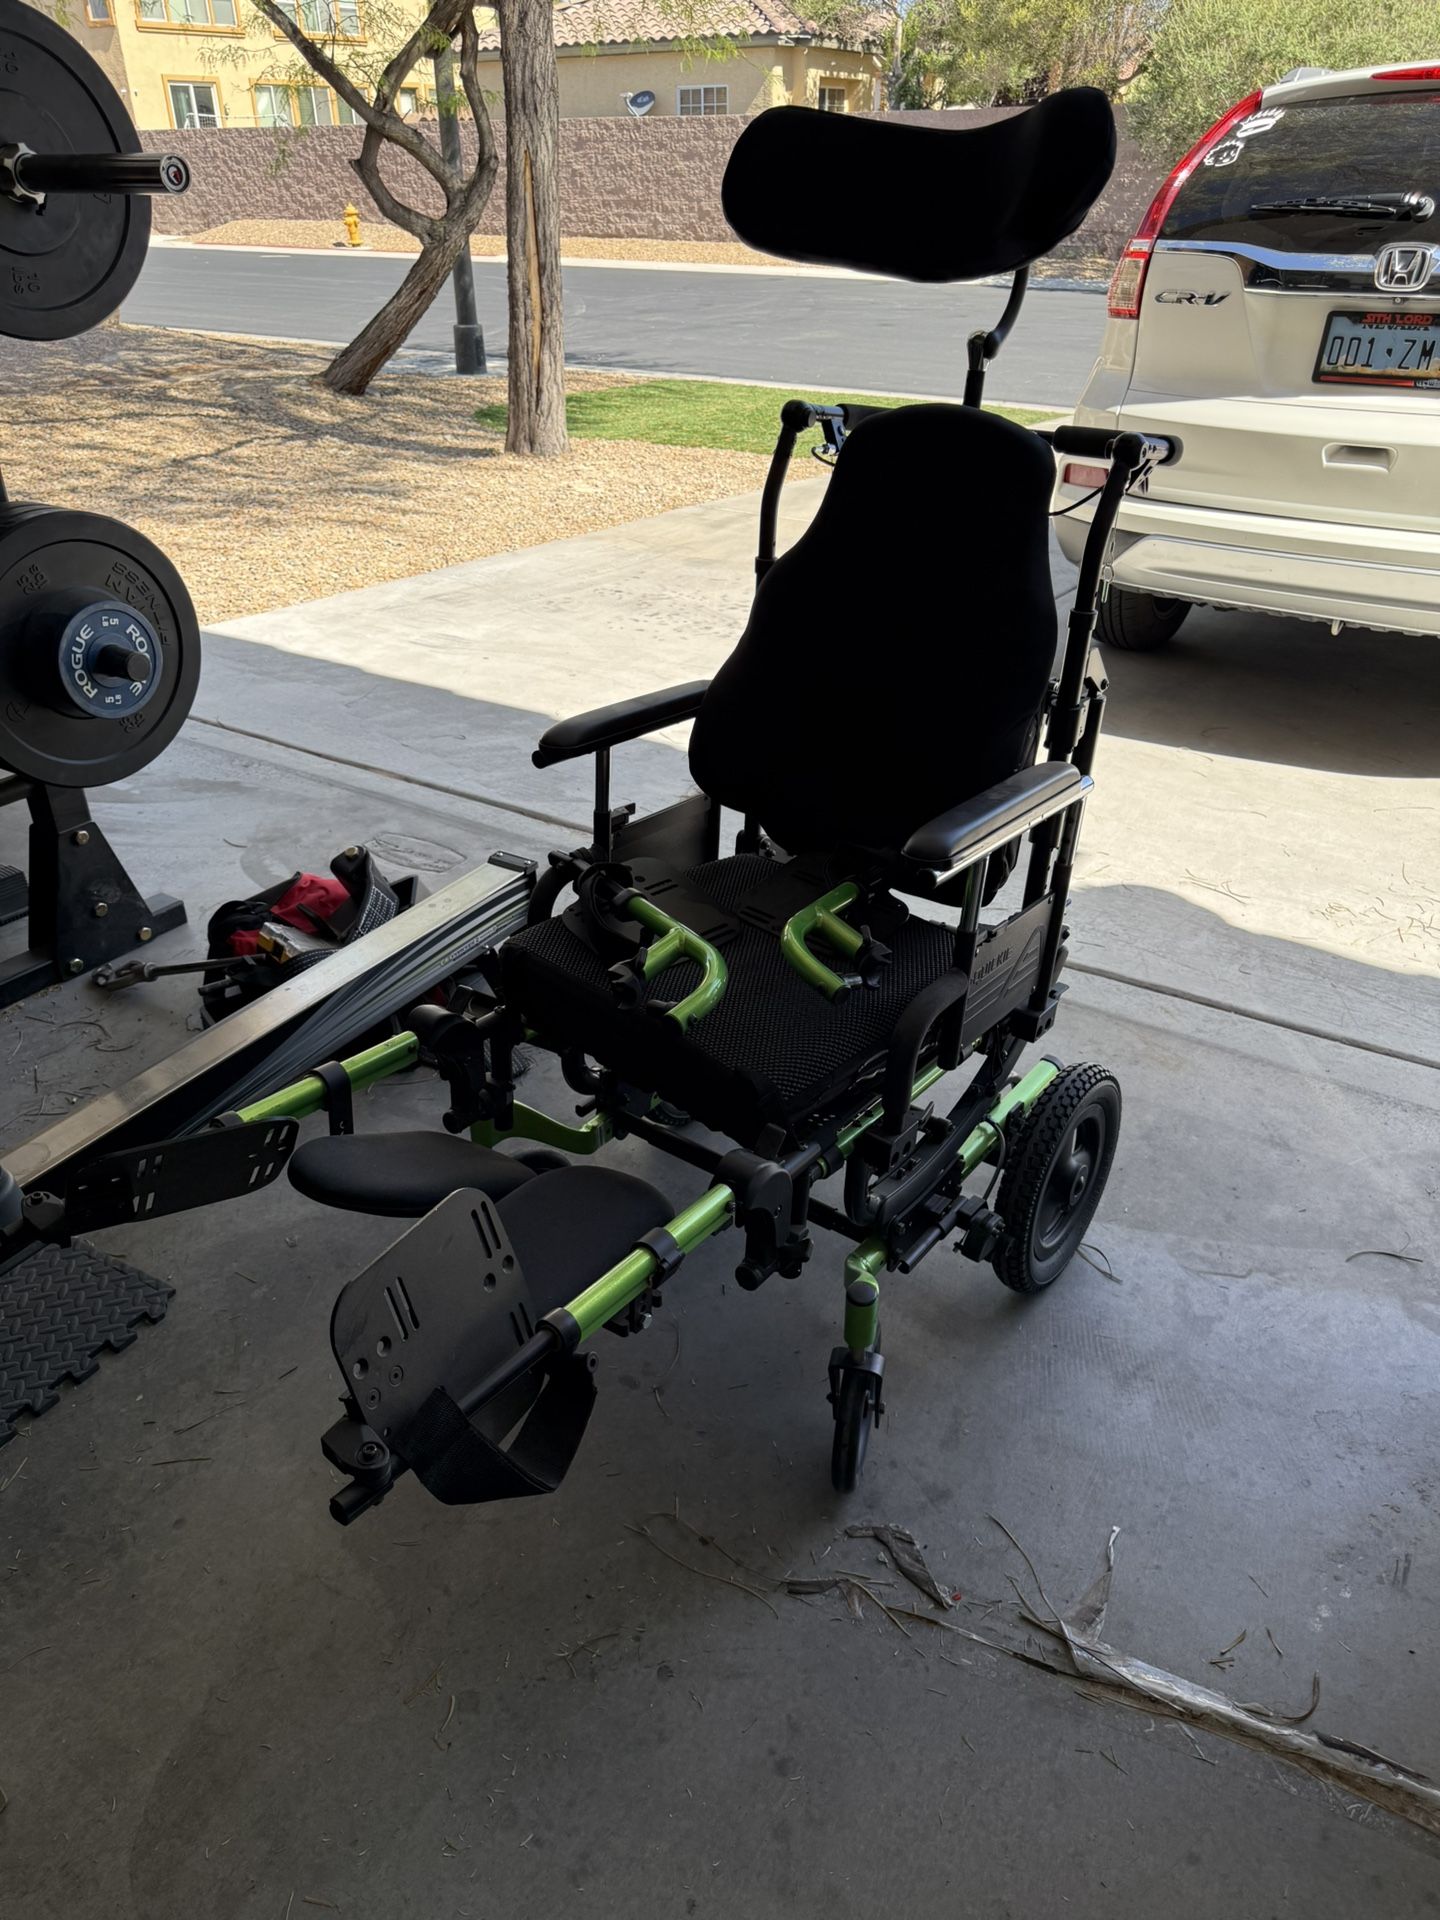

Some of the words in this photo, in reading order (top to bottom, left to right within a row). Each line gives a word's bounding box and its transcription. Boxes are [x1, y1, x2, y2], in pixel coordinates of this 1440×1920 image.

[1154, 289, 1231, 307] CR-V
[1361, 313, 1391, 324] SITH
[1395, 314, 1433, 326] LORD
[1397, 339, 1440, 371] ZM
[71, 623, 98, 699] ROGUE
[125, 623, 150, 697] ROE
